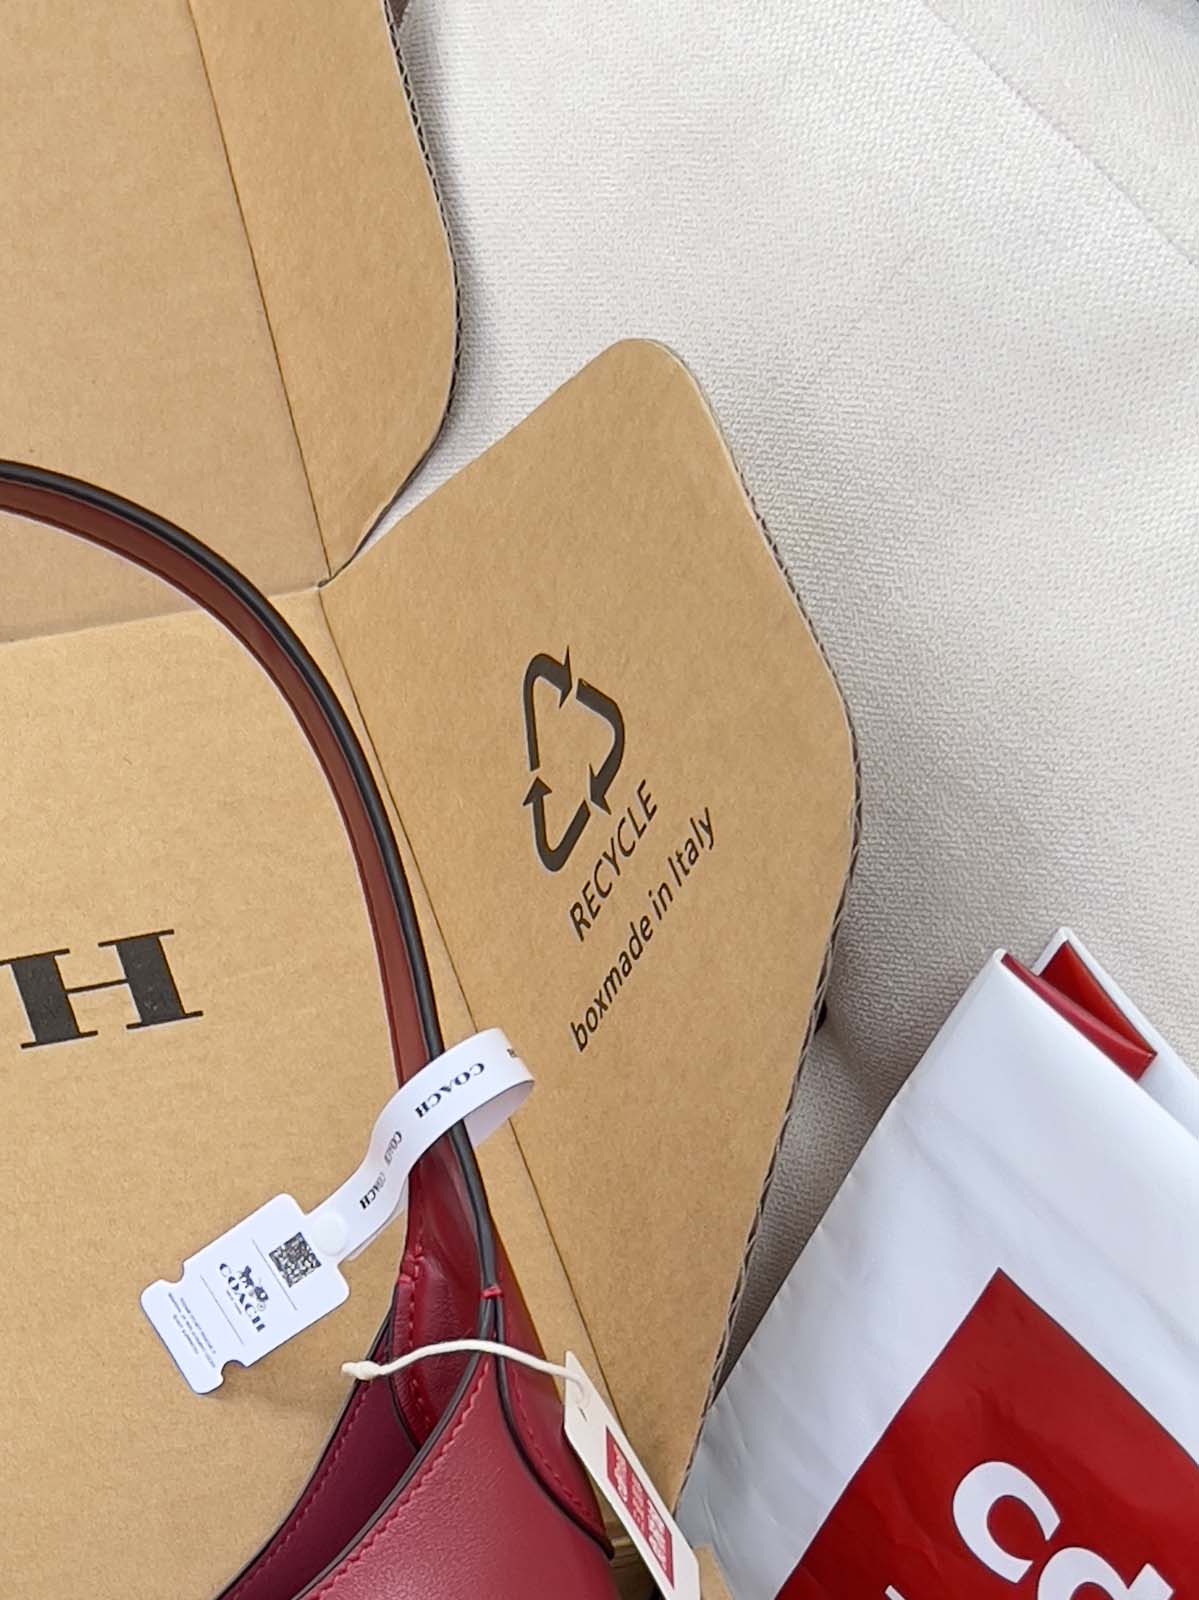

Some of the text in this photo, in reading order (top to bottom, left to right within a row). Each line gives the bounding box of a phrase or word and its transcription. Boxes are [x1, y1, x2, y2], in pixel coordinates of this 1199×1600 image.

[569, 779, 658, 942] RECYCLE
[570, 807, 715, 1052] boxmade in Italy
[414, 1062, 485, 1119] COACH
[219, 1263, 266, 1332] COACH
